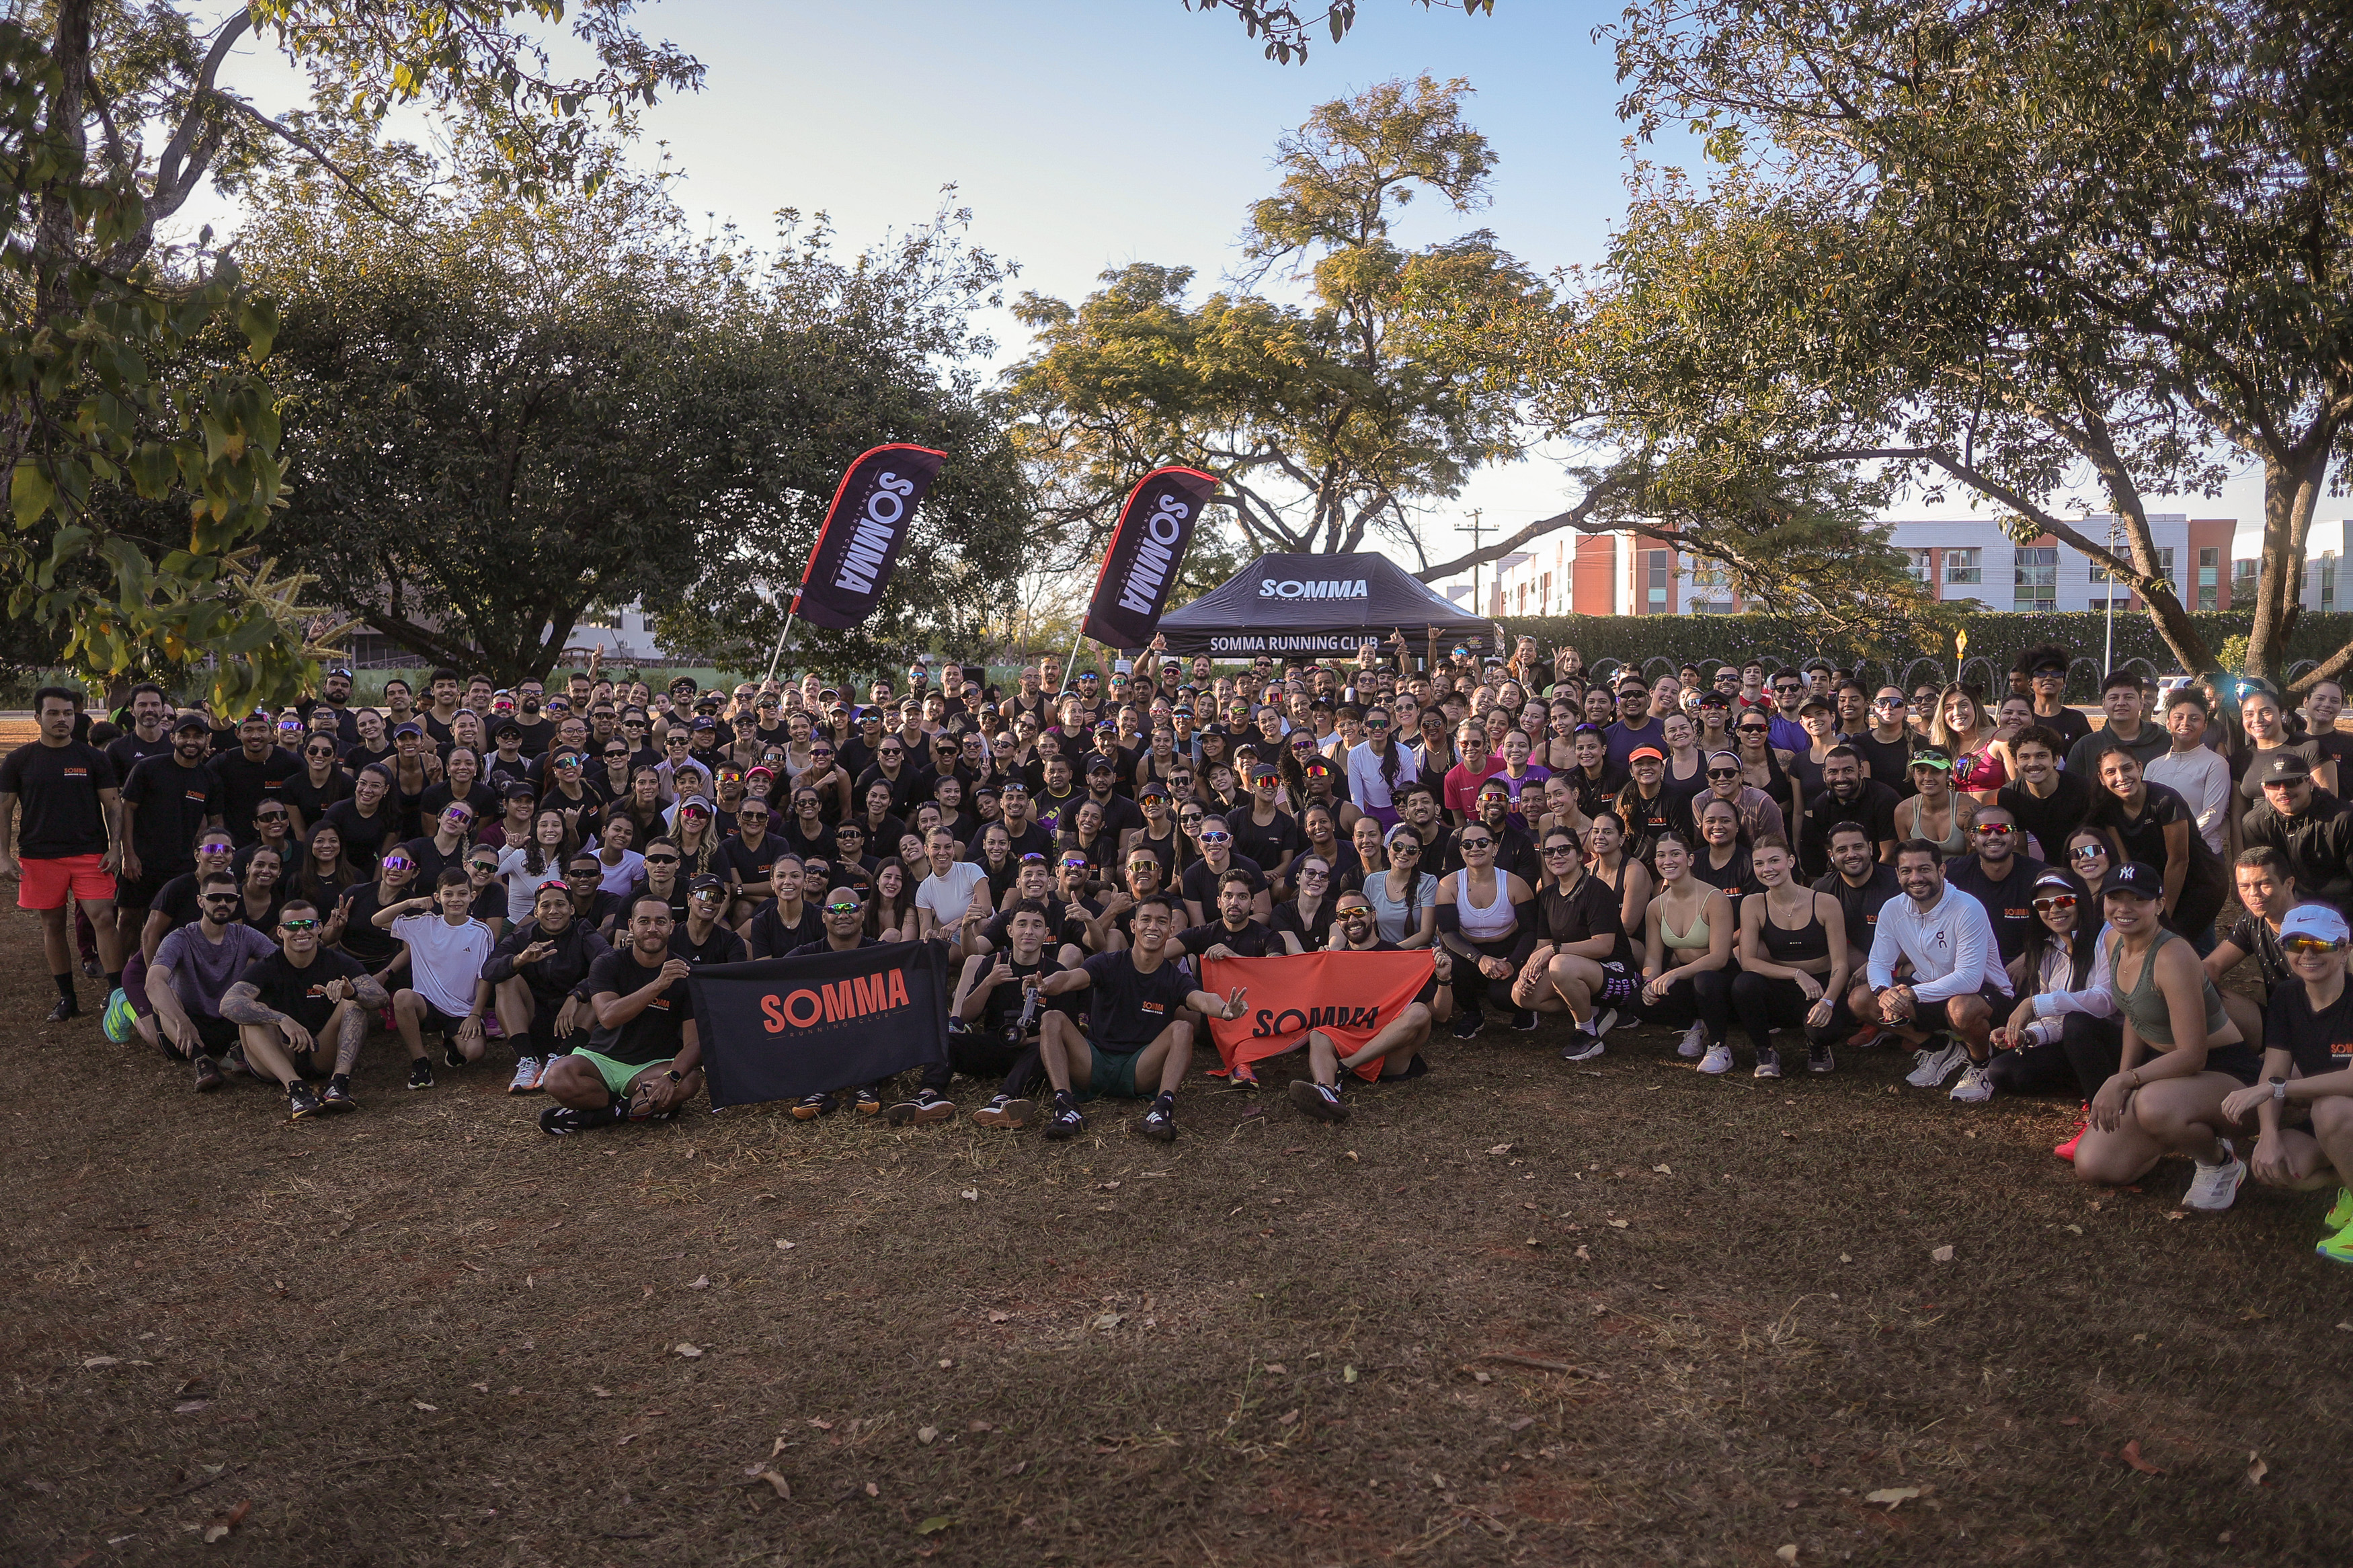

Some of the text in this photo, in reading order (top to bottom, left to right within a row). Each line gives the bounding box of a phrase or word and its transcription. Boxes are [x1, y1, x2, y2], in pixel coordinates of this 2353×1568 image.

[835, 471, 914, 594] SOMMA
[836, 484, 873, 565] RUNNING CLUB
[1121, 504, 1154, 583] RUNNING CLUB
[1119, 494, 1189, 615] SOMMA
[1259, 579, 1368, 597] SOMMA
[1209, 636, 1378, 651] SOMMA RUNNING CLUB
[2118, 865, 2135, 880] NY
[760, 968, 910, 1033] SOMMA
[1142, 1001, 1164, 1012] SOMMA
[789, 1012, 889, 1038] RUNNING CLUB
